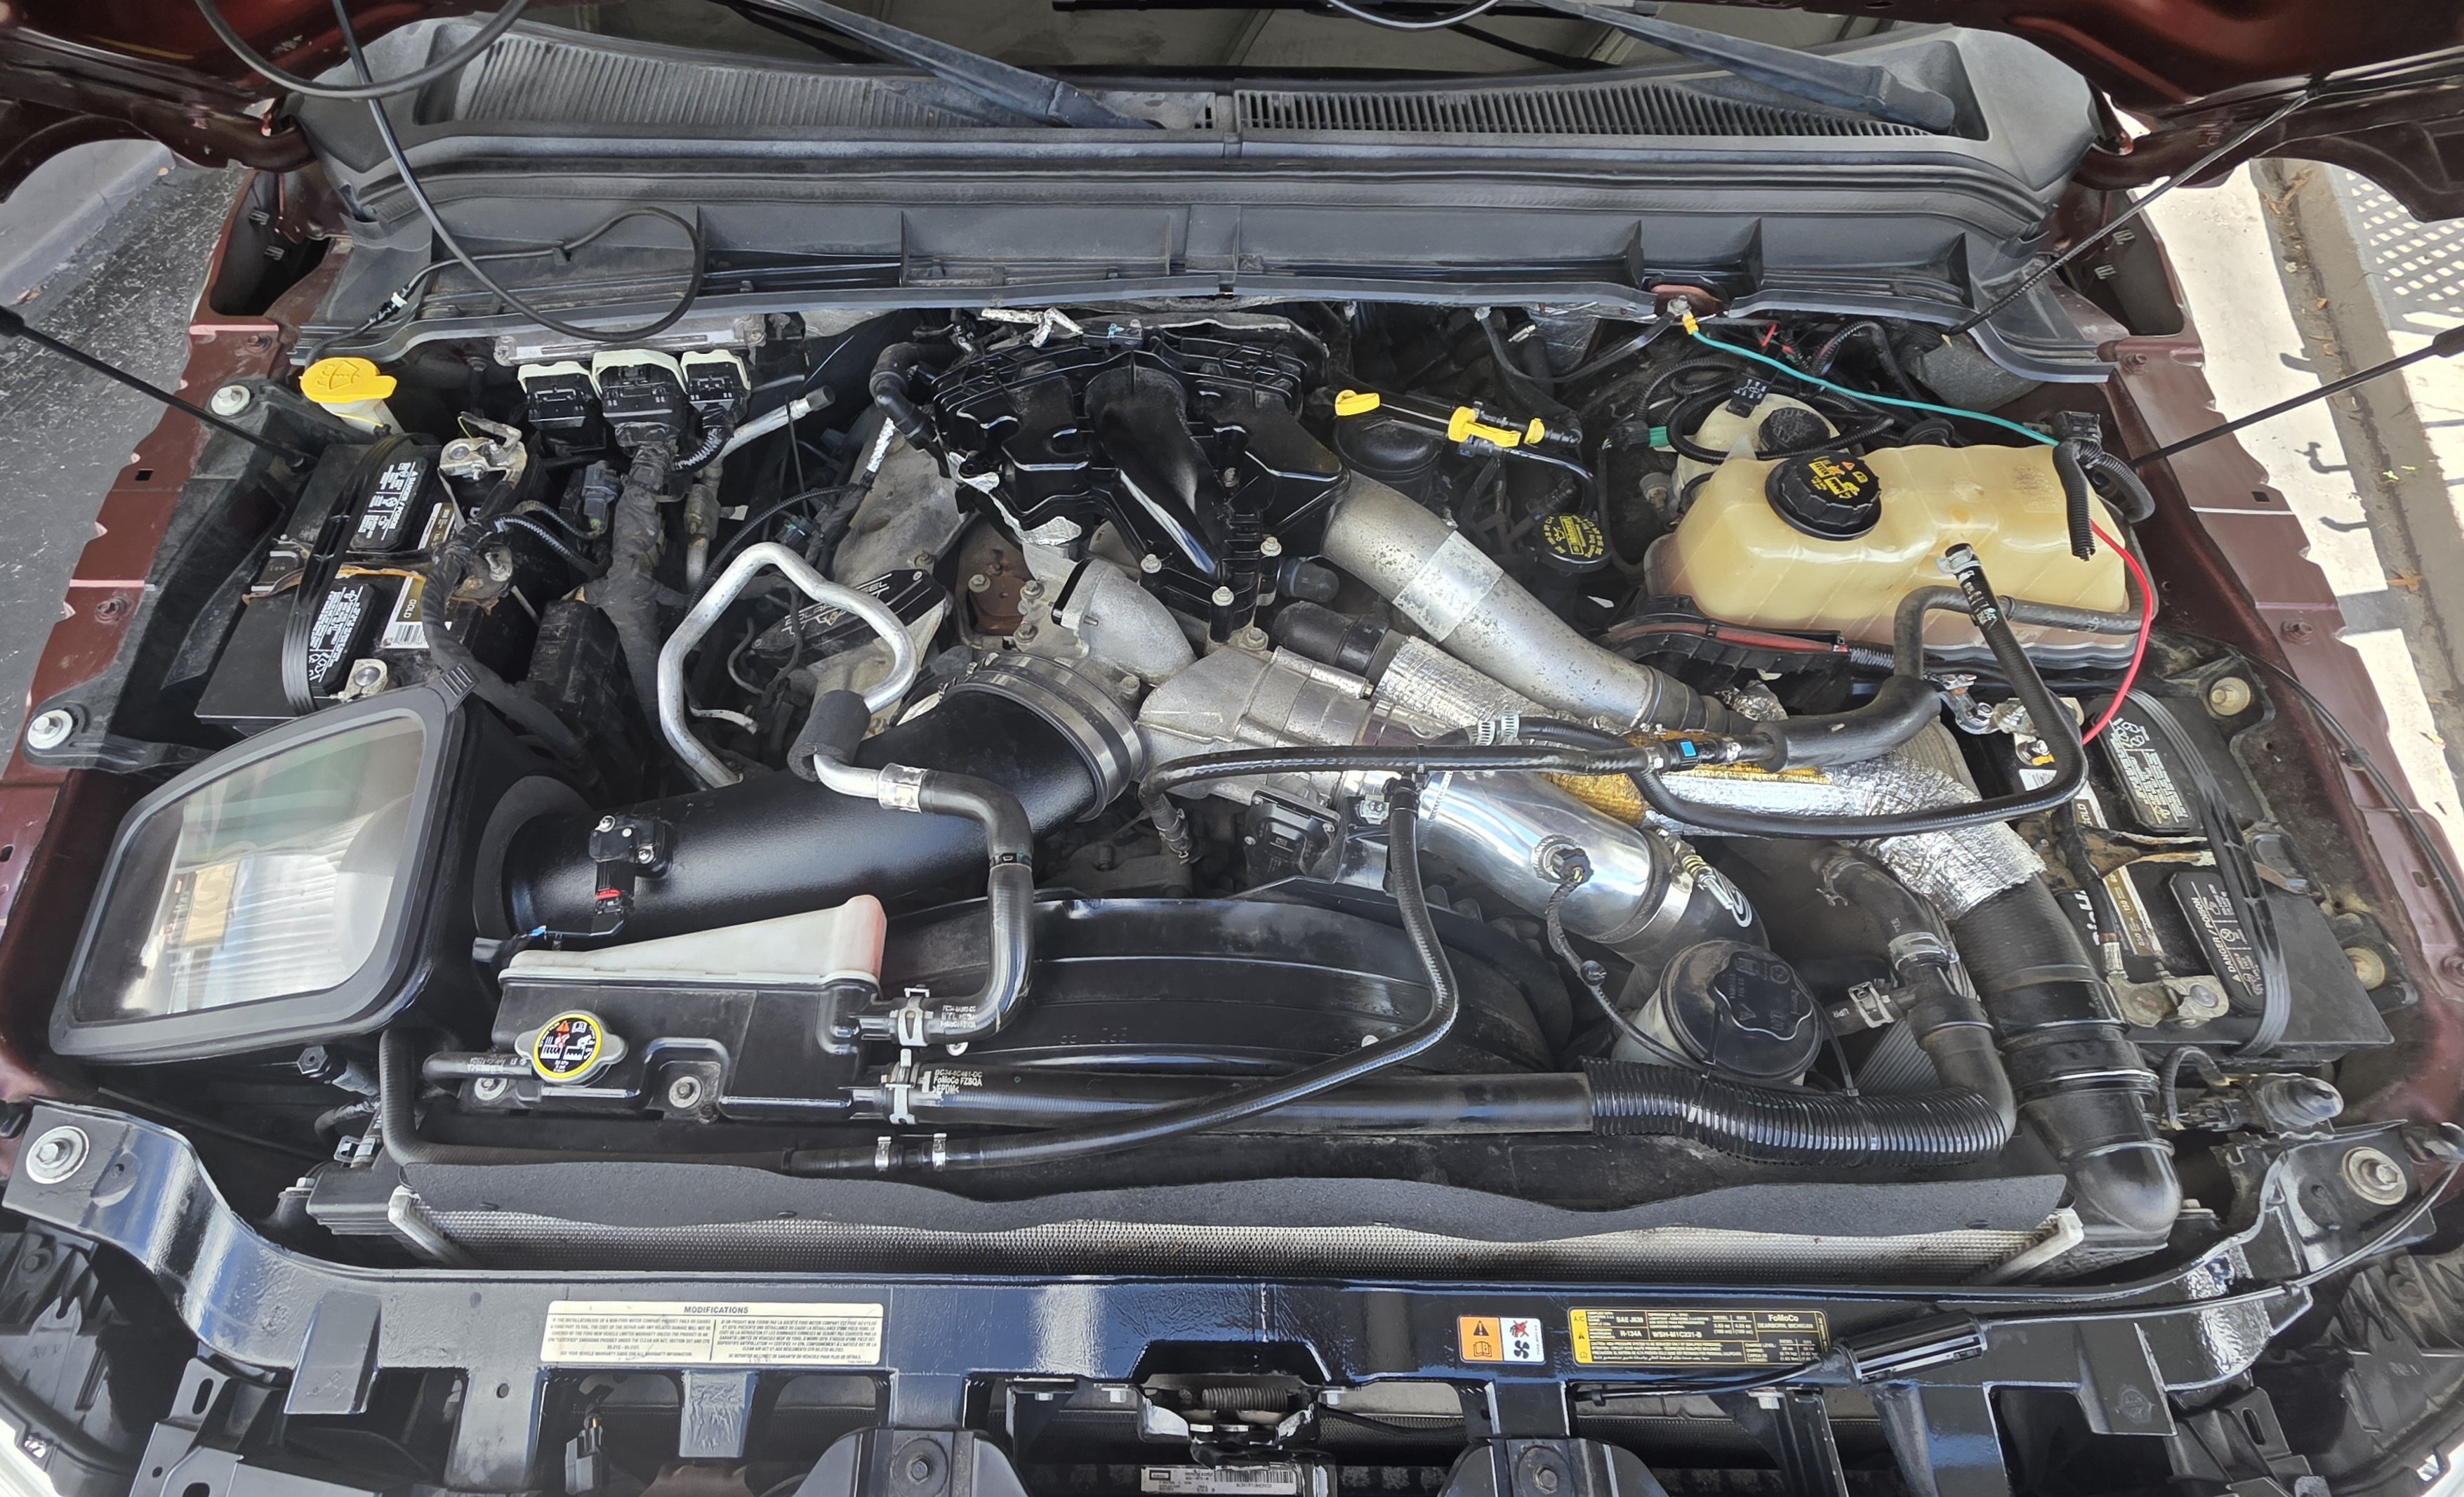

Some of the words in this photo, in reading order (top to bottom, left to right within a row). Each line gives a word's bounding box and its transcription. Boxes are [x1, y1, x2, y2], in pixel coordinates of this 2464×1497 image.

[404, 599, 417, 619] GOLD
[2192, 897, 2213, 928] POISON
[2212, 937, 2236, 974] DANGER
[1832, 1008, 1850, 1018] UPR
[933, 1076, 959, 1085] FoMoCo
[684, 1306, 748, 1314] MODIFICATIONS
